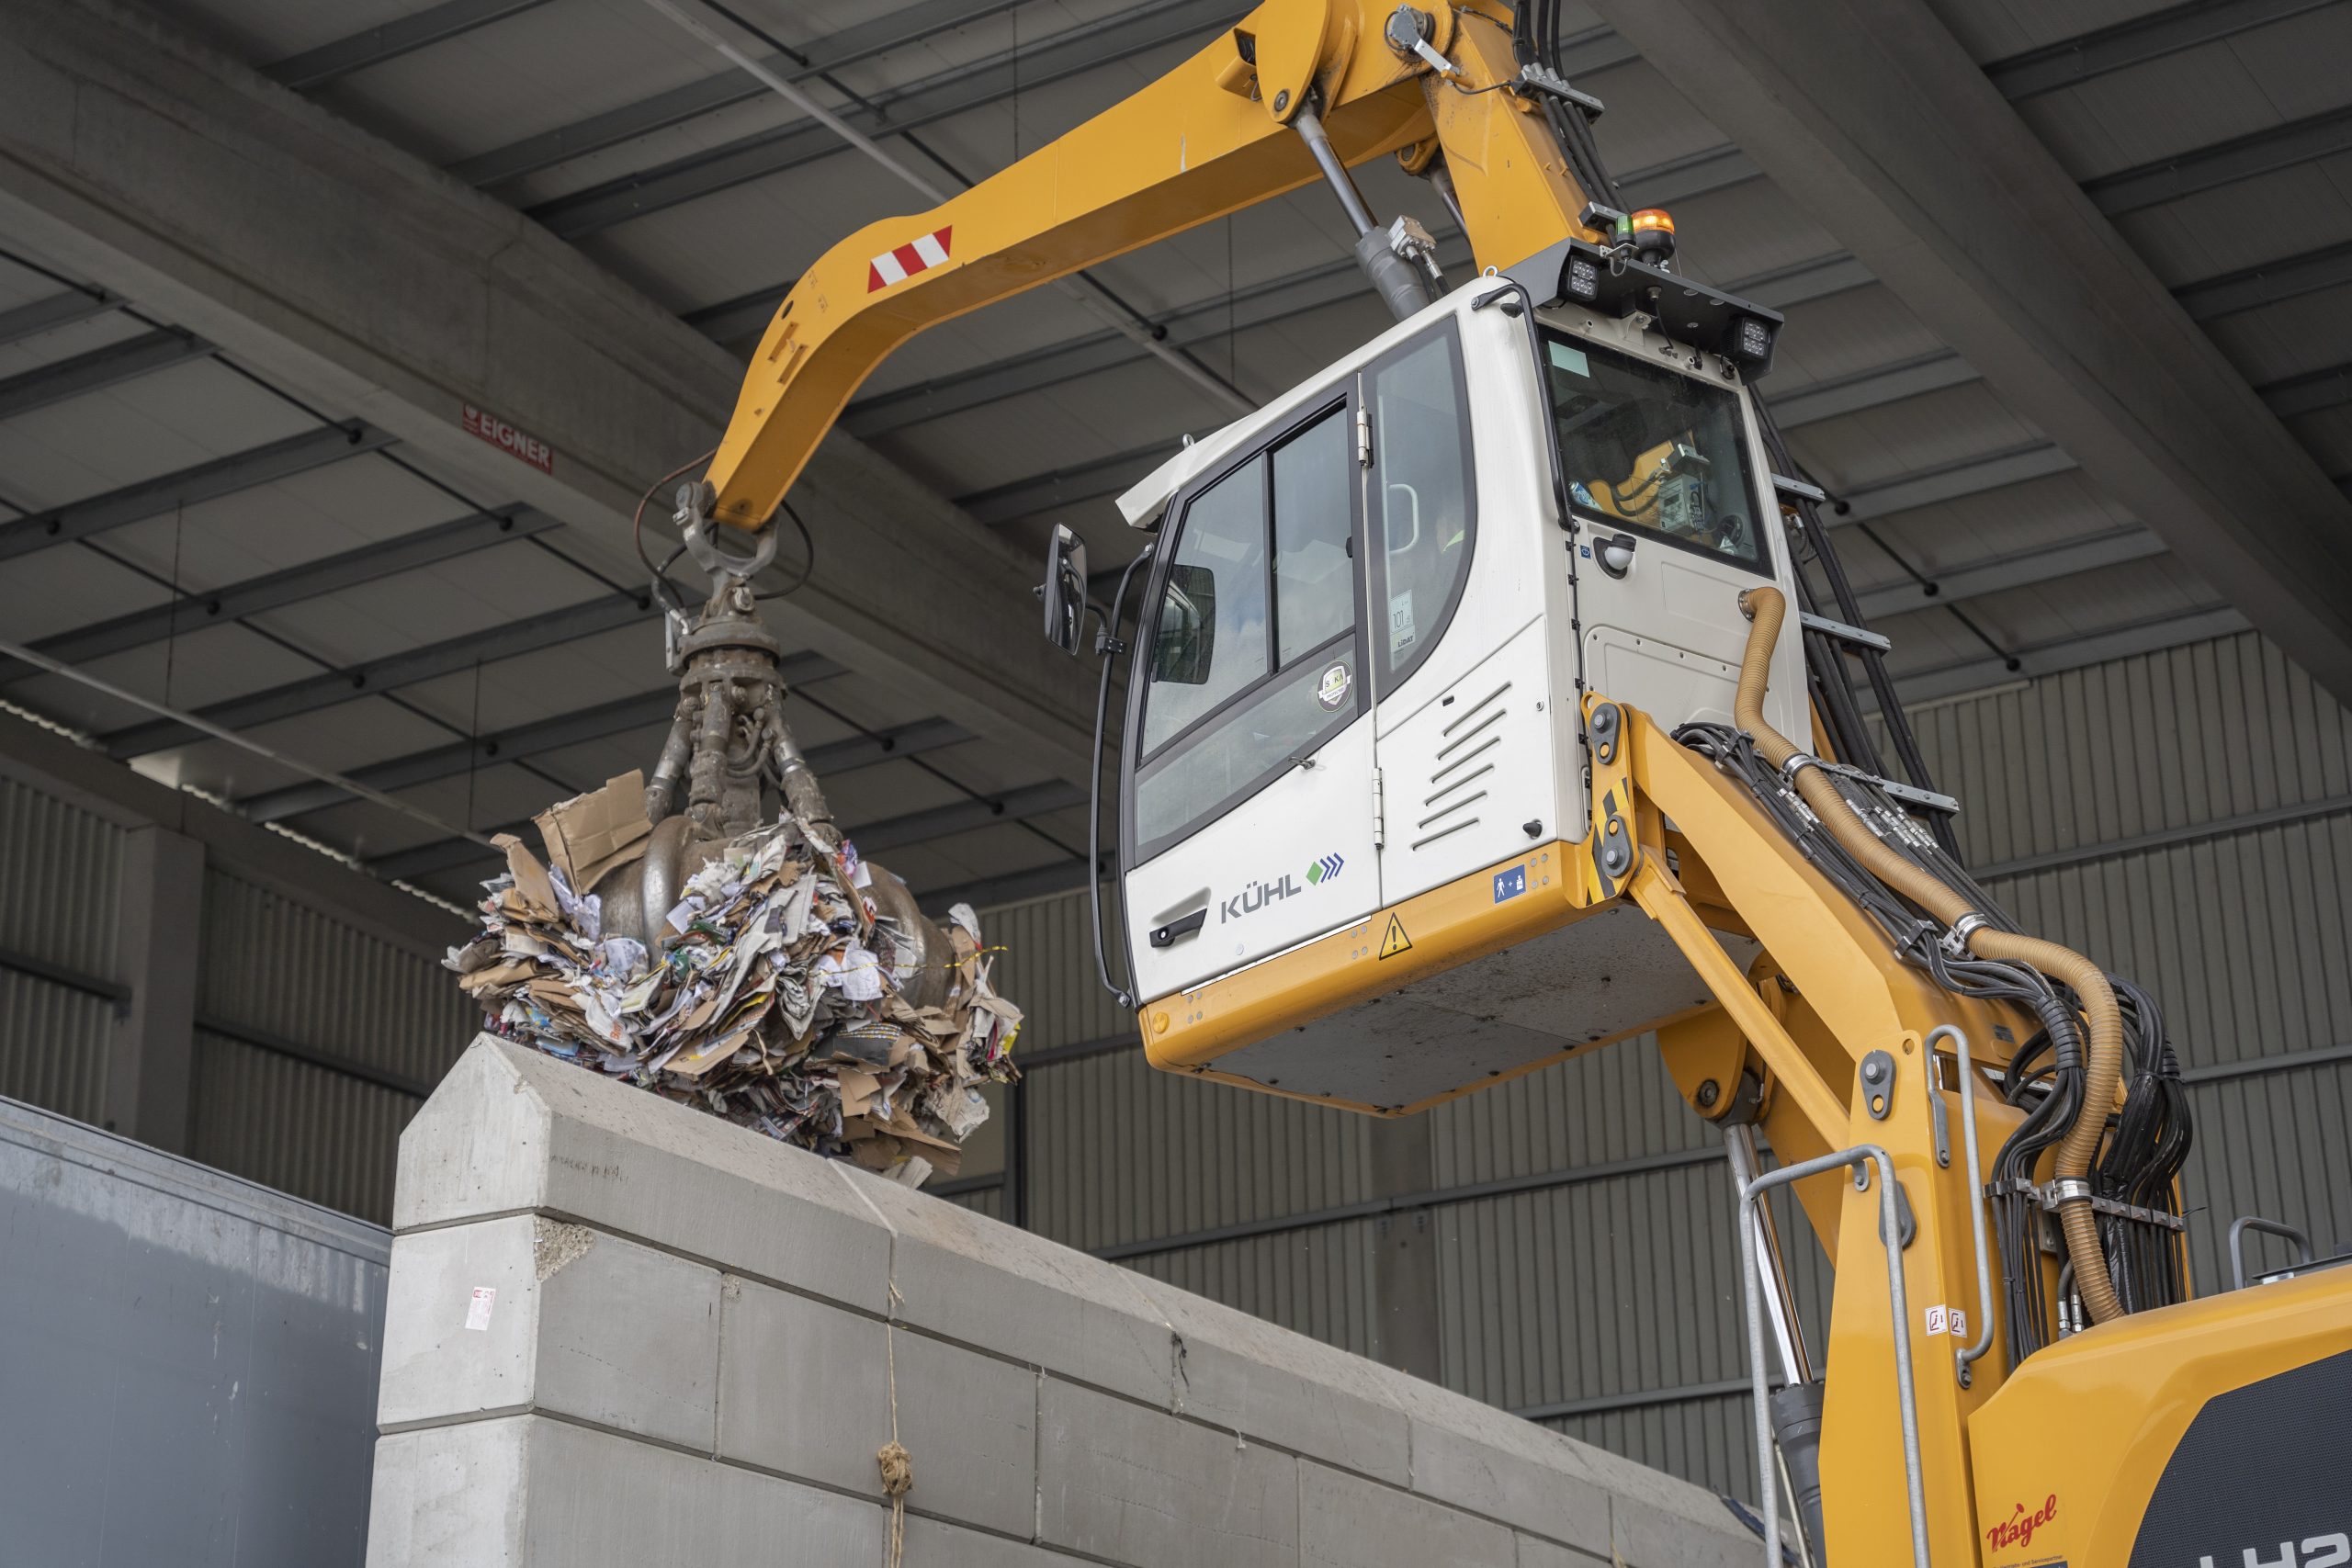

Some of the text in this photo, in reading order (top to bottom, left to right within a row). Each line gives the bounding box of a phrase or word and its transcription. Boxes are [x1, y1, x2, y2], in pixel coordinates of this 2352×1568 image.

[480, 413, 549, 468] EIGNER
[1393, 610, 1404, 629] 101
[1326, 673, 1343, 688] SKA
[1220, 874, 1302, 925] KÜHL
